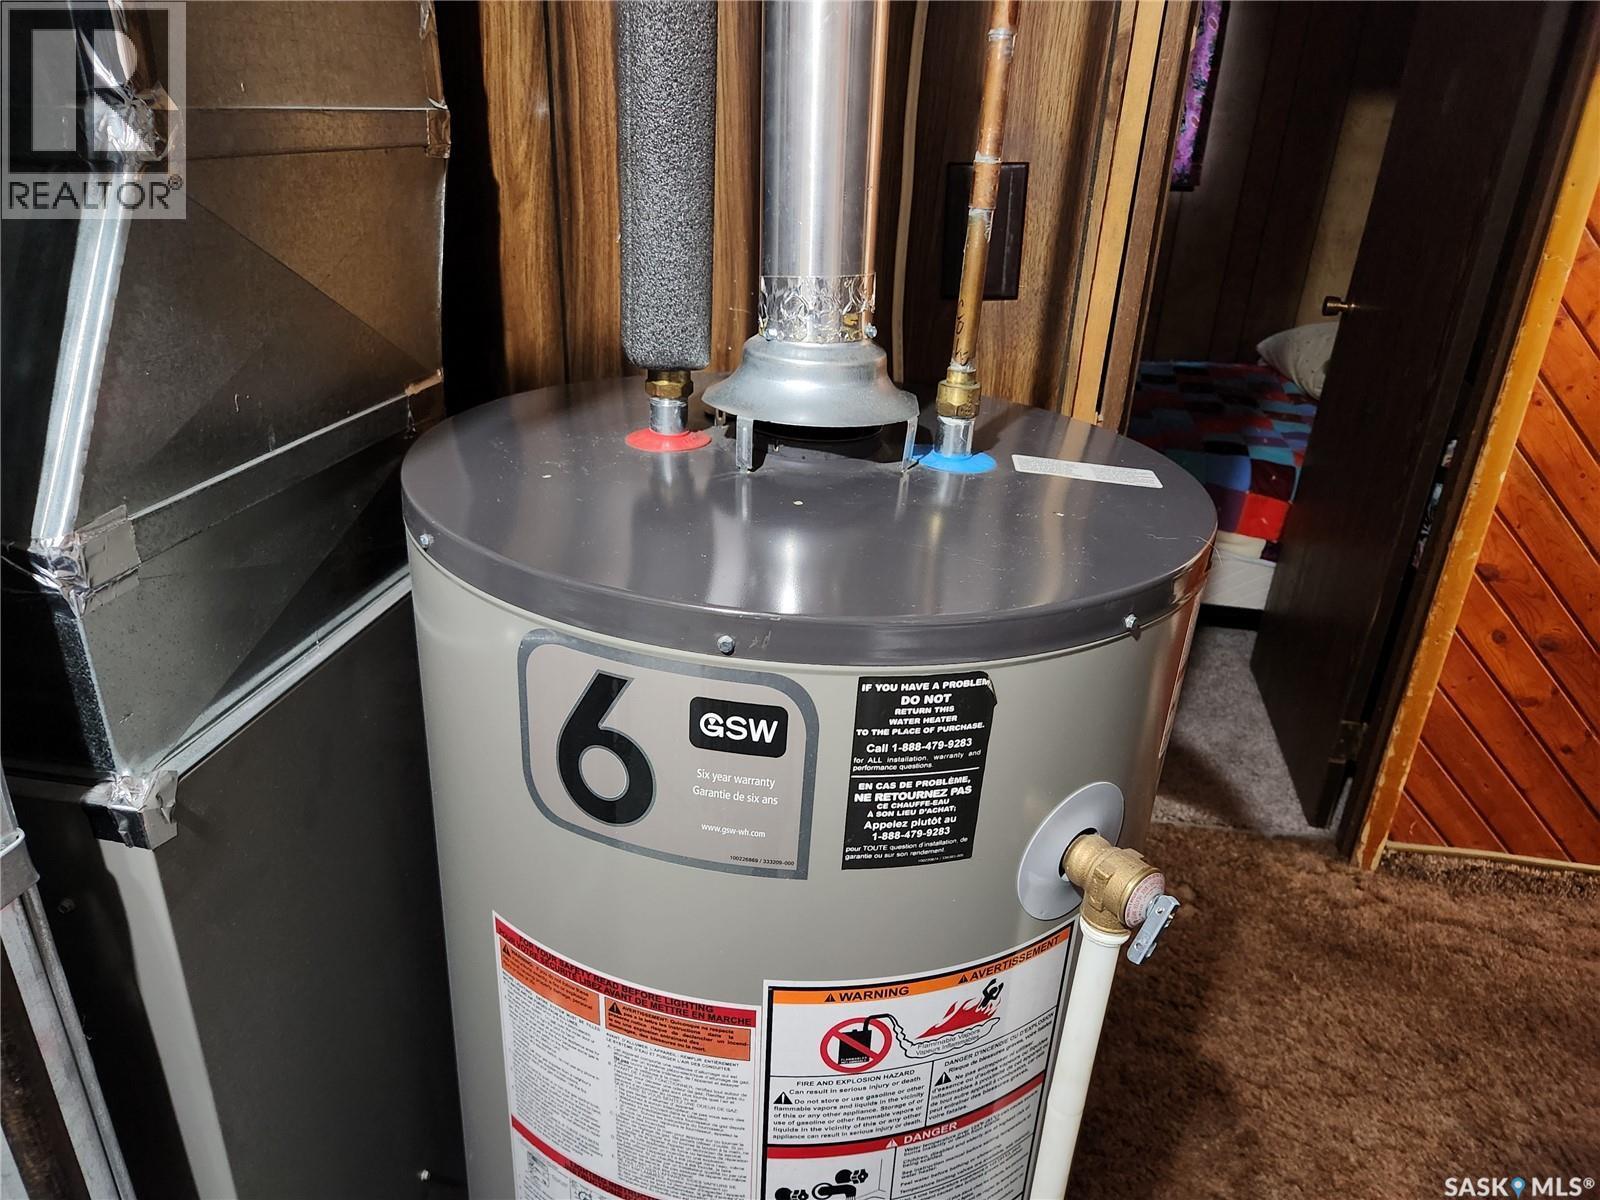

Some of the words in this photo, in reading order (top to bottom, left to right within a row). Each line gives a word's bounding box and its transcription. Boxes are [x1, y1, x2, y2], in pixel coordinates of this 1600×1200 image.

[861, 683, 873, 692] IF
[875, 683, 898, 692] YOU
[901, 682, 930, 692] HAVE
[931, 682, 940, 690] A
[901, 695, 920, 705] DO
[924, 693, 952, 704] NOT
[895, 707, 932, 715] RETURN
[934, 705, 955, 713] THIS
[699, 711, 779, 744] GSW
[889, 717, 921, 725] WATER
[923, 715, 958, 724] HEATER
[856, 728, 869, 736] TO
[871, 728, 890, 736] THE
[891, 727, 921, 735] PLACE
[923, 726, 935, 734] OF
[937, 722, 985, 733] PURCHASE.
[556, 668, 657, 827] 6
[866, 743, 889, 753] Call
[892, 737, 972, 753] 1-888-479-9283
[933, 752, 964, 760] warranty
[968, 749, 982, 757] and
[852, 764, 897, 772] performance
[696, 768, 710, 779] Six
[711, 772, 732, 783] year
[733, 775, 776, 790] warranty
[858, 782, 873, 790] EN
[875, 781, 897, 790] CAS
[899, 780, 913, 789] DE
[692, 785, 731, 800] Garantie
[732, 791, 745, 802] de
[746, 793, 760, 804] six
[761, 796, 779, 805] ans
[854, 792, 872, 802] NE
[874, 788, 949, 802] RETOURNEZ
[950, 785, 972, 796] PAS
[876, 802, 889, 810] CE
[890, 798, 950, 809] CHAUFFE-EAU
[875, 810, 895, 818] SON
[896, 808, 917, 817] LIEU
[701, 823, 766, 838] www.gsw-wh.com
[863, 819, 908, 831] Appelez
[910, 816, 942, 829] plutôt
[943, 816, 957, 824] au
[872, 826, 950, 841] 1-888-479-9283
[889, 842, 917, 851] question
[844, 853, 872, 861] garantie
[970, 935, 1060, 981] AVERTISSEMENT
[535, 945, 557, 963] YOUR
[559, 957, 592, 977] SAFETY
[594, 973, 619, 989] READ
[621, 984, 661, 1002] BEFORE
[664, 996, 714, 1013] LIGHTING
[839, 986, 909, 1002] WARNING
[604, 986, 634, 1002] AVANT
[635, 997, 648, 1007] DE
[650, 1001, 689, 1018] METTRE
[692, 1010, 705, 1020] EN
[708, 1013, 752, 1026] MARCHE
[917, 1036, 957, 1049] Flammable
[958, 1029, 981, 1042] Vapors
[916, 1045, 941, 1056] Vapeurs
[836, 1075, 881, 1085] EXPLOSION
[883, 1069, 915, 1079] HAZARD
[839, 1085, 867, 1093] serious
[868, 1082, 890, 1090] injury
[901, 1076, 921, 1085] death
[865, 1090, 896, 1101] gasoline
[906, 1085, 925, 1093] other
[813, 1104, 837, 1112] vapors
[854, 1101, 878, 1109] liquids
[900, 1091, 925, 1101] vicinity
[822, 1110, 841, 1118] other
[880, 1102, 906, 1110] Storage
[856, 1111, 891, 1121] flammable
[891, 1107, 914, 1116] vapors
[824, 1123, 851, 1131] vicinity
[887, 1116, 901, 1124] any
[902, 1112, 921, 1121] other
[820, 1131, 840, 1139] result
[849, 1127, 874, 1136] serious
[875, 1124, 894, 1133] injury
[904, 1121, 958, 1144] DANGER
